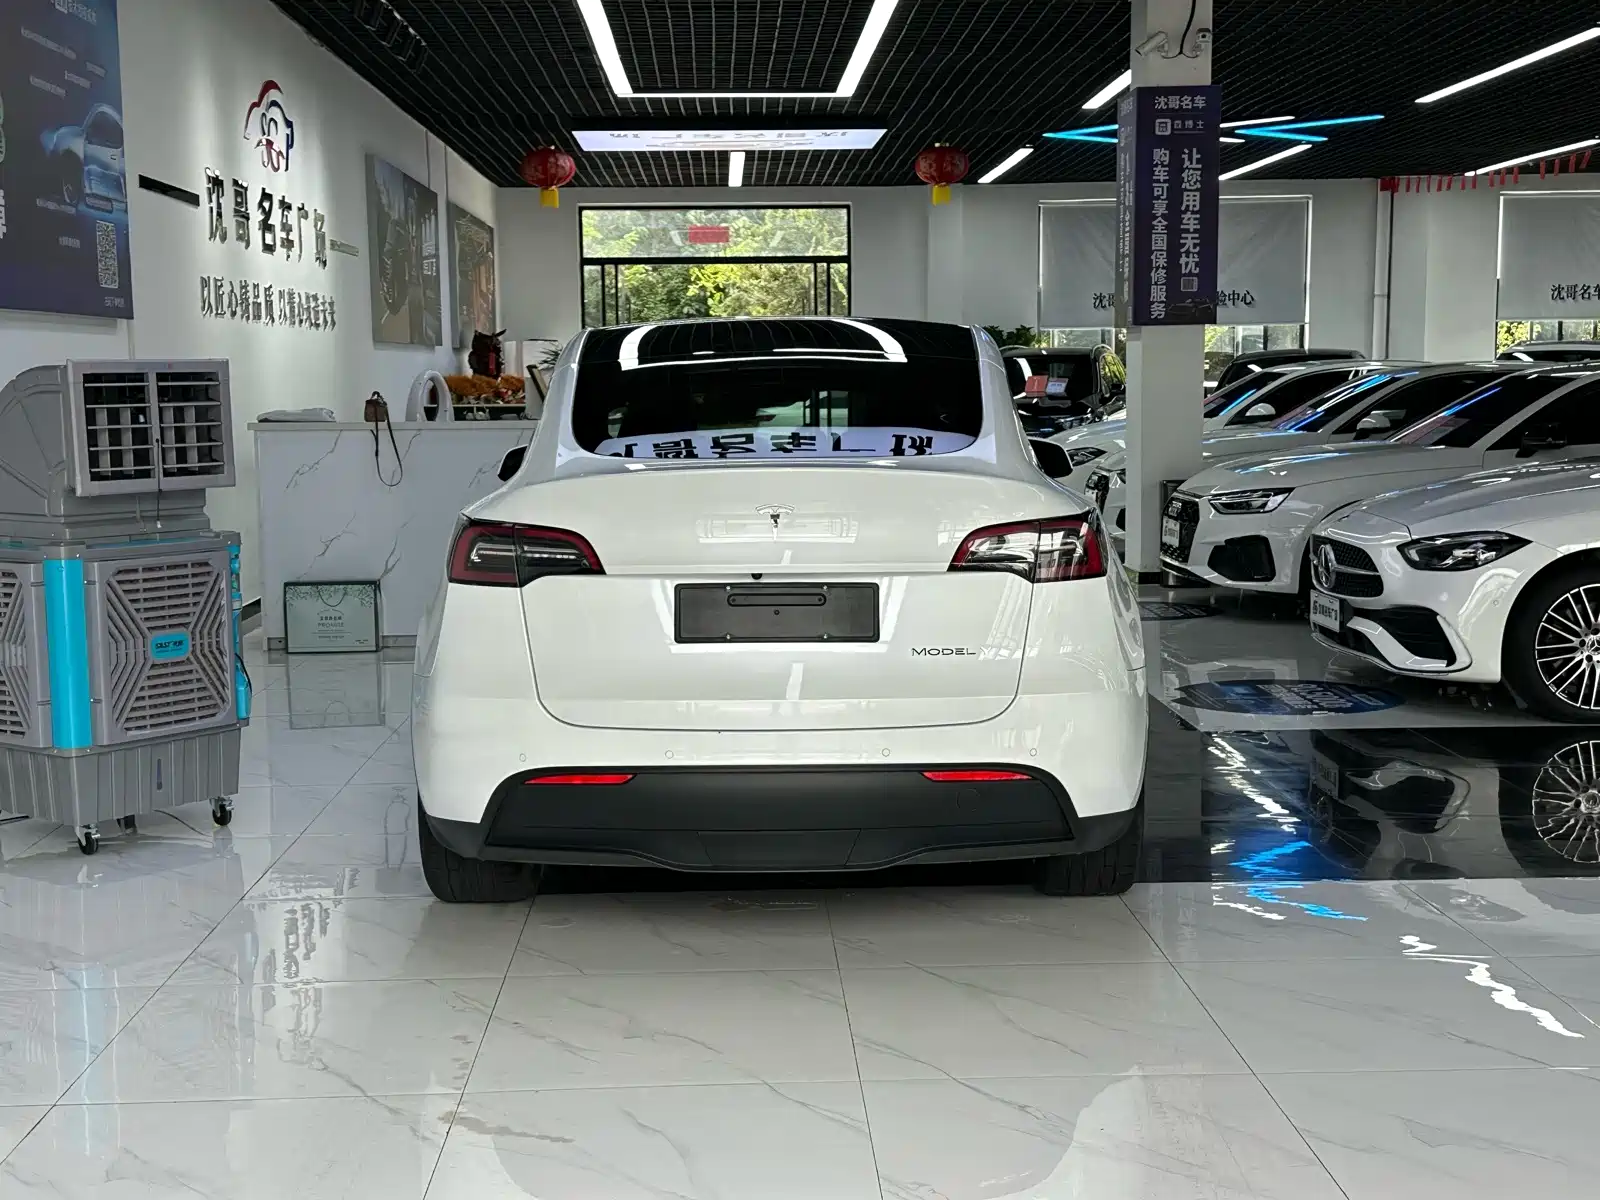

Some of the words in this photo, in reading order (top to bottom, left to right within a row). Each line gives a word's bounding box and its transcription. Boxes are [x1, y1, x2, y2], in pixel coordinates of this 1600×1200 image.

[1155, 95, 1206, 109] 沈哥名车
[1150, 148, 1170, 319] 购车可享全国保修服务
[1179, 148, 1202, 274] 让您用车无忧
[911, 648, 977, 656] MODEL
